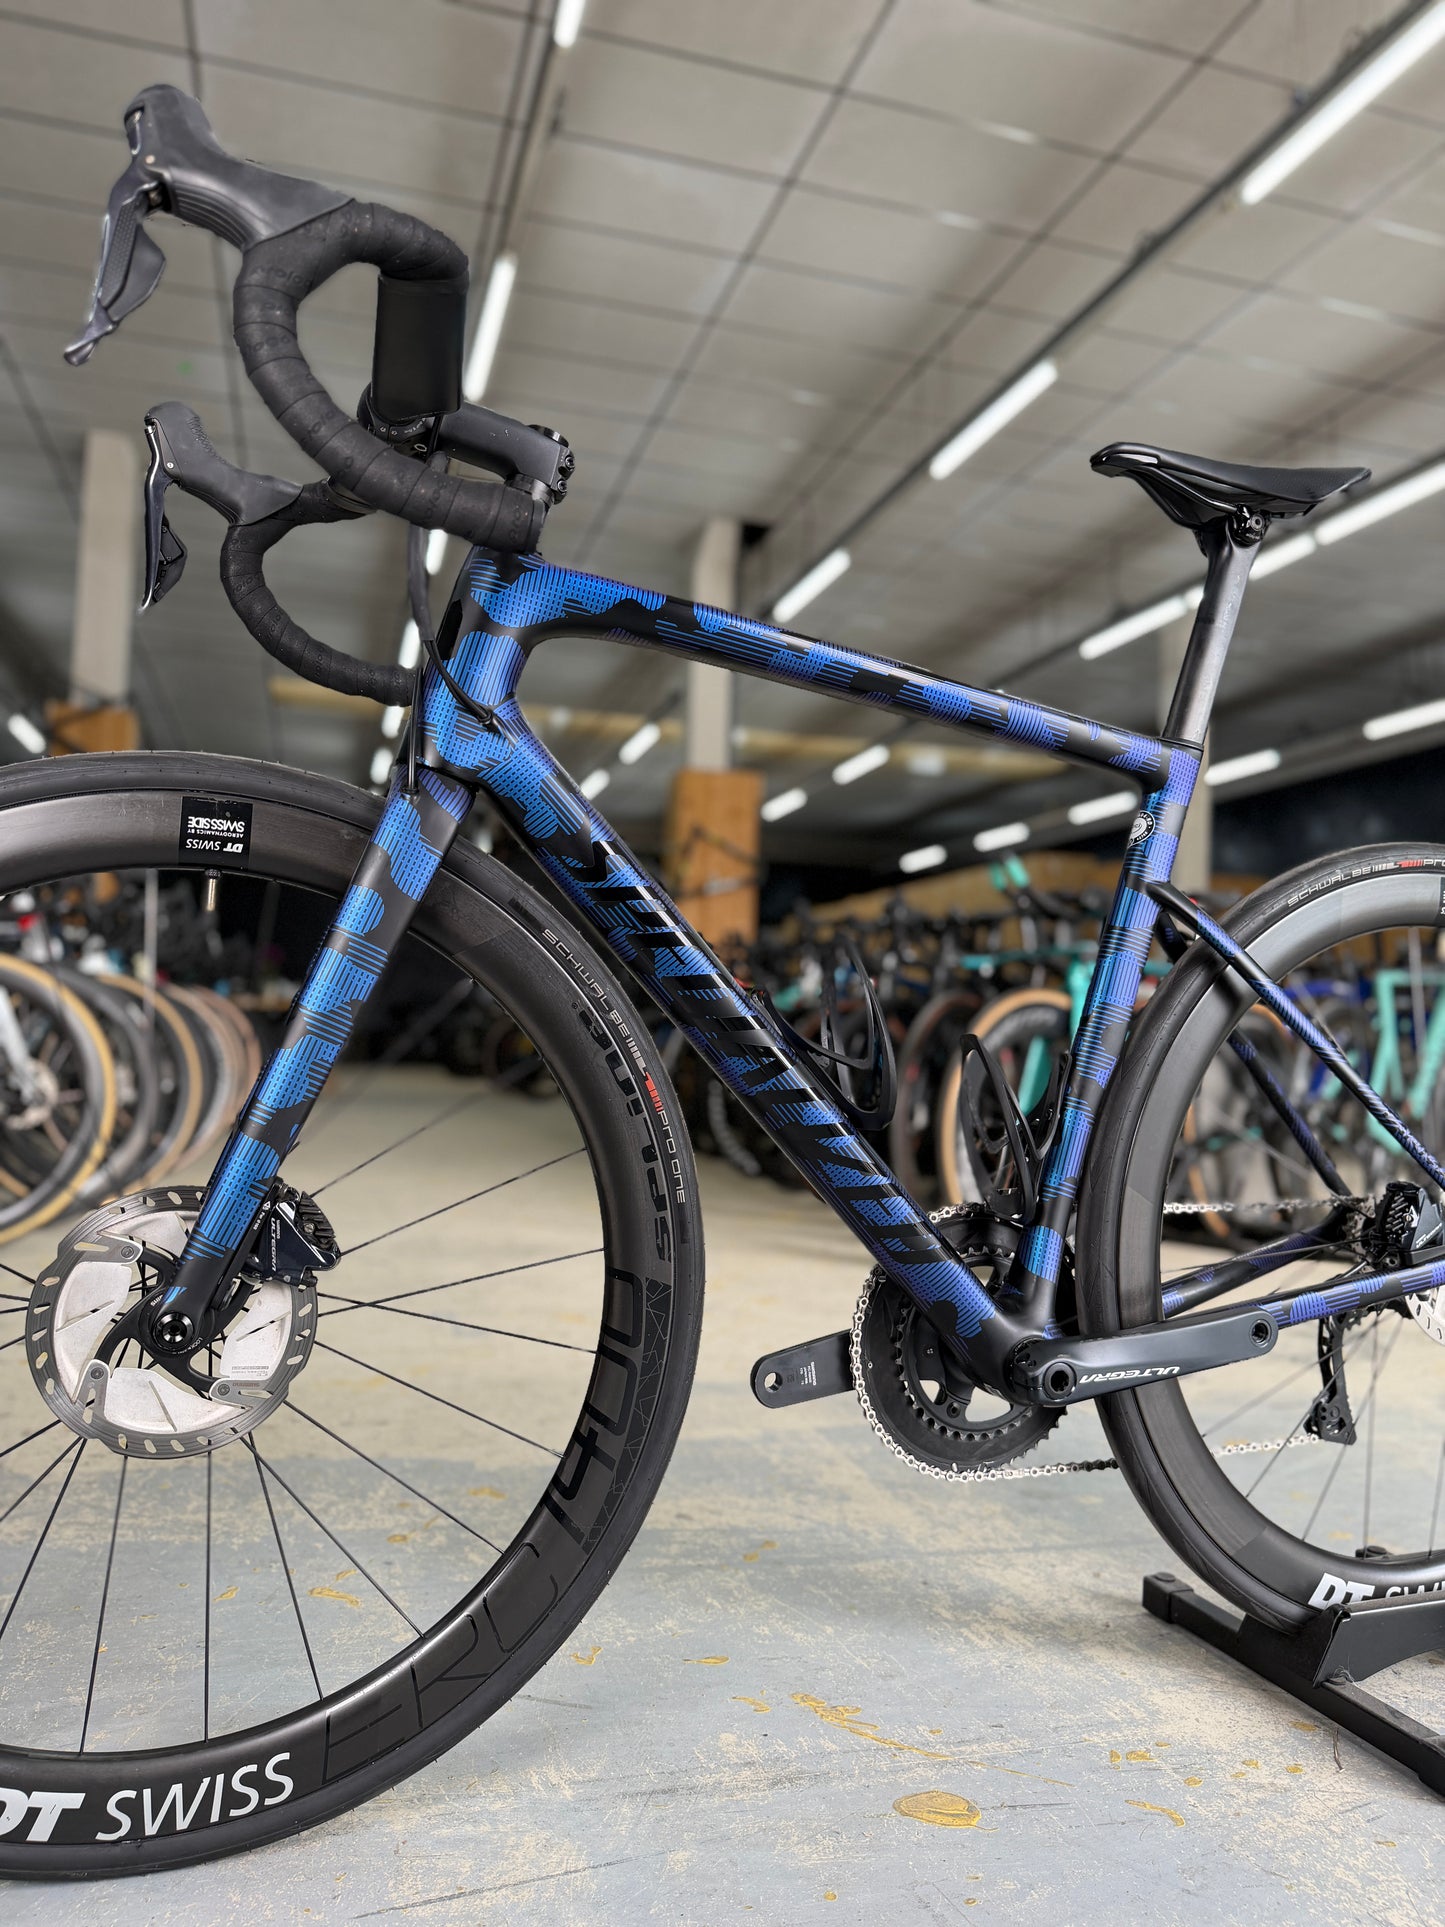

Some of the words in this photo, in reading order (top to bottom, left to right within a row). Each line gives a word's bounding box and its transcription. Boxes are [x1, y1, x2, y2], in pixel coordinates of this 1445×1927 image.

[185, 838, 222, 851] SWISS
[196, 829, 244, 839] AERODYNAMICS
[222, 842, 244, 854] DT
[1287, 865, 1372, 907] SCHWALBE
[541, 928, 631, 1040] SCHWALBE
[560, 838, 958, 1265] SPECIALIZED
[1079, 1366, 1181, 1384] ULTEGRA
[322, 1541, 560, 1785] ERC
[541, 1265, 646, 1551] 1400
[95, 1751, 294, 1841] SWISS
